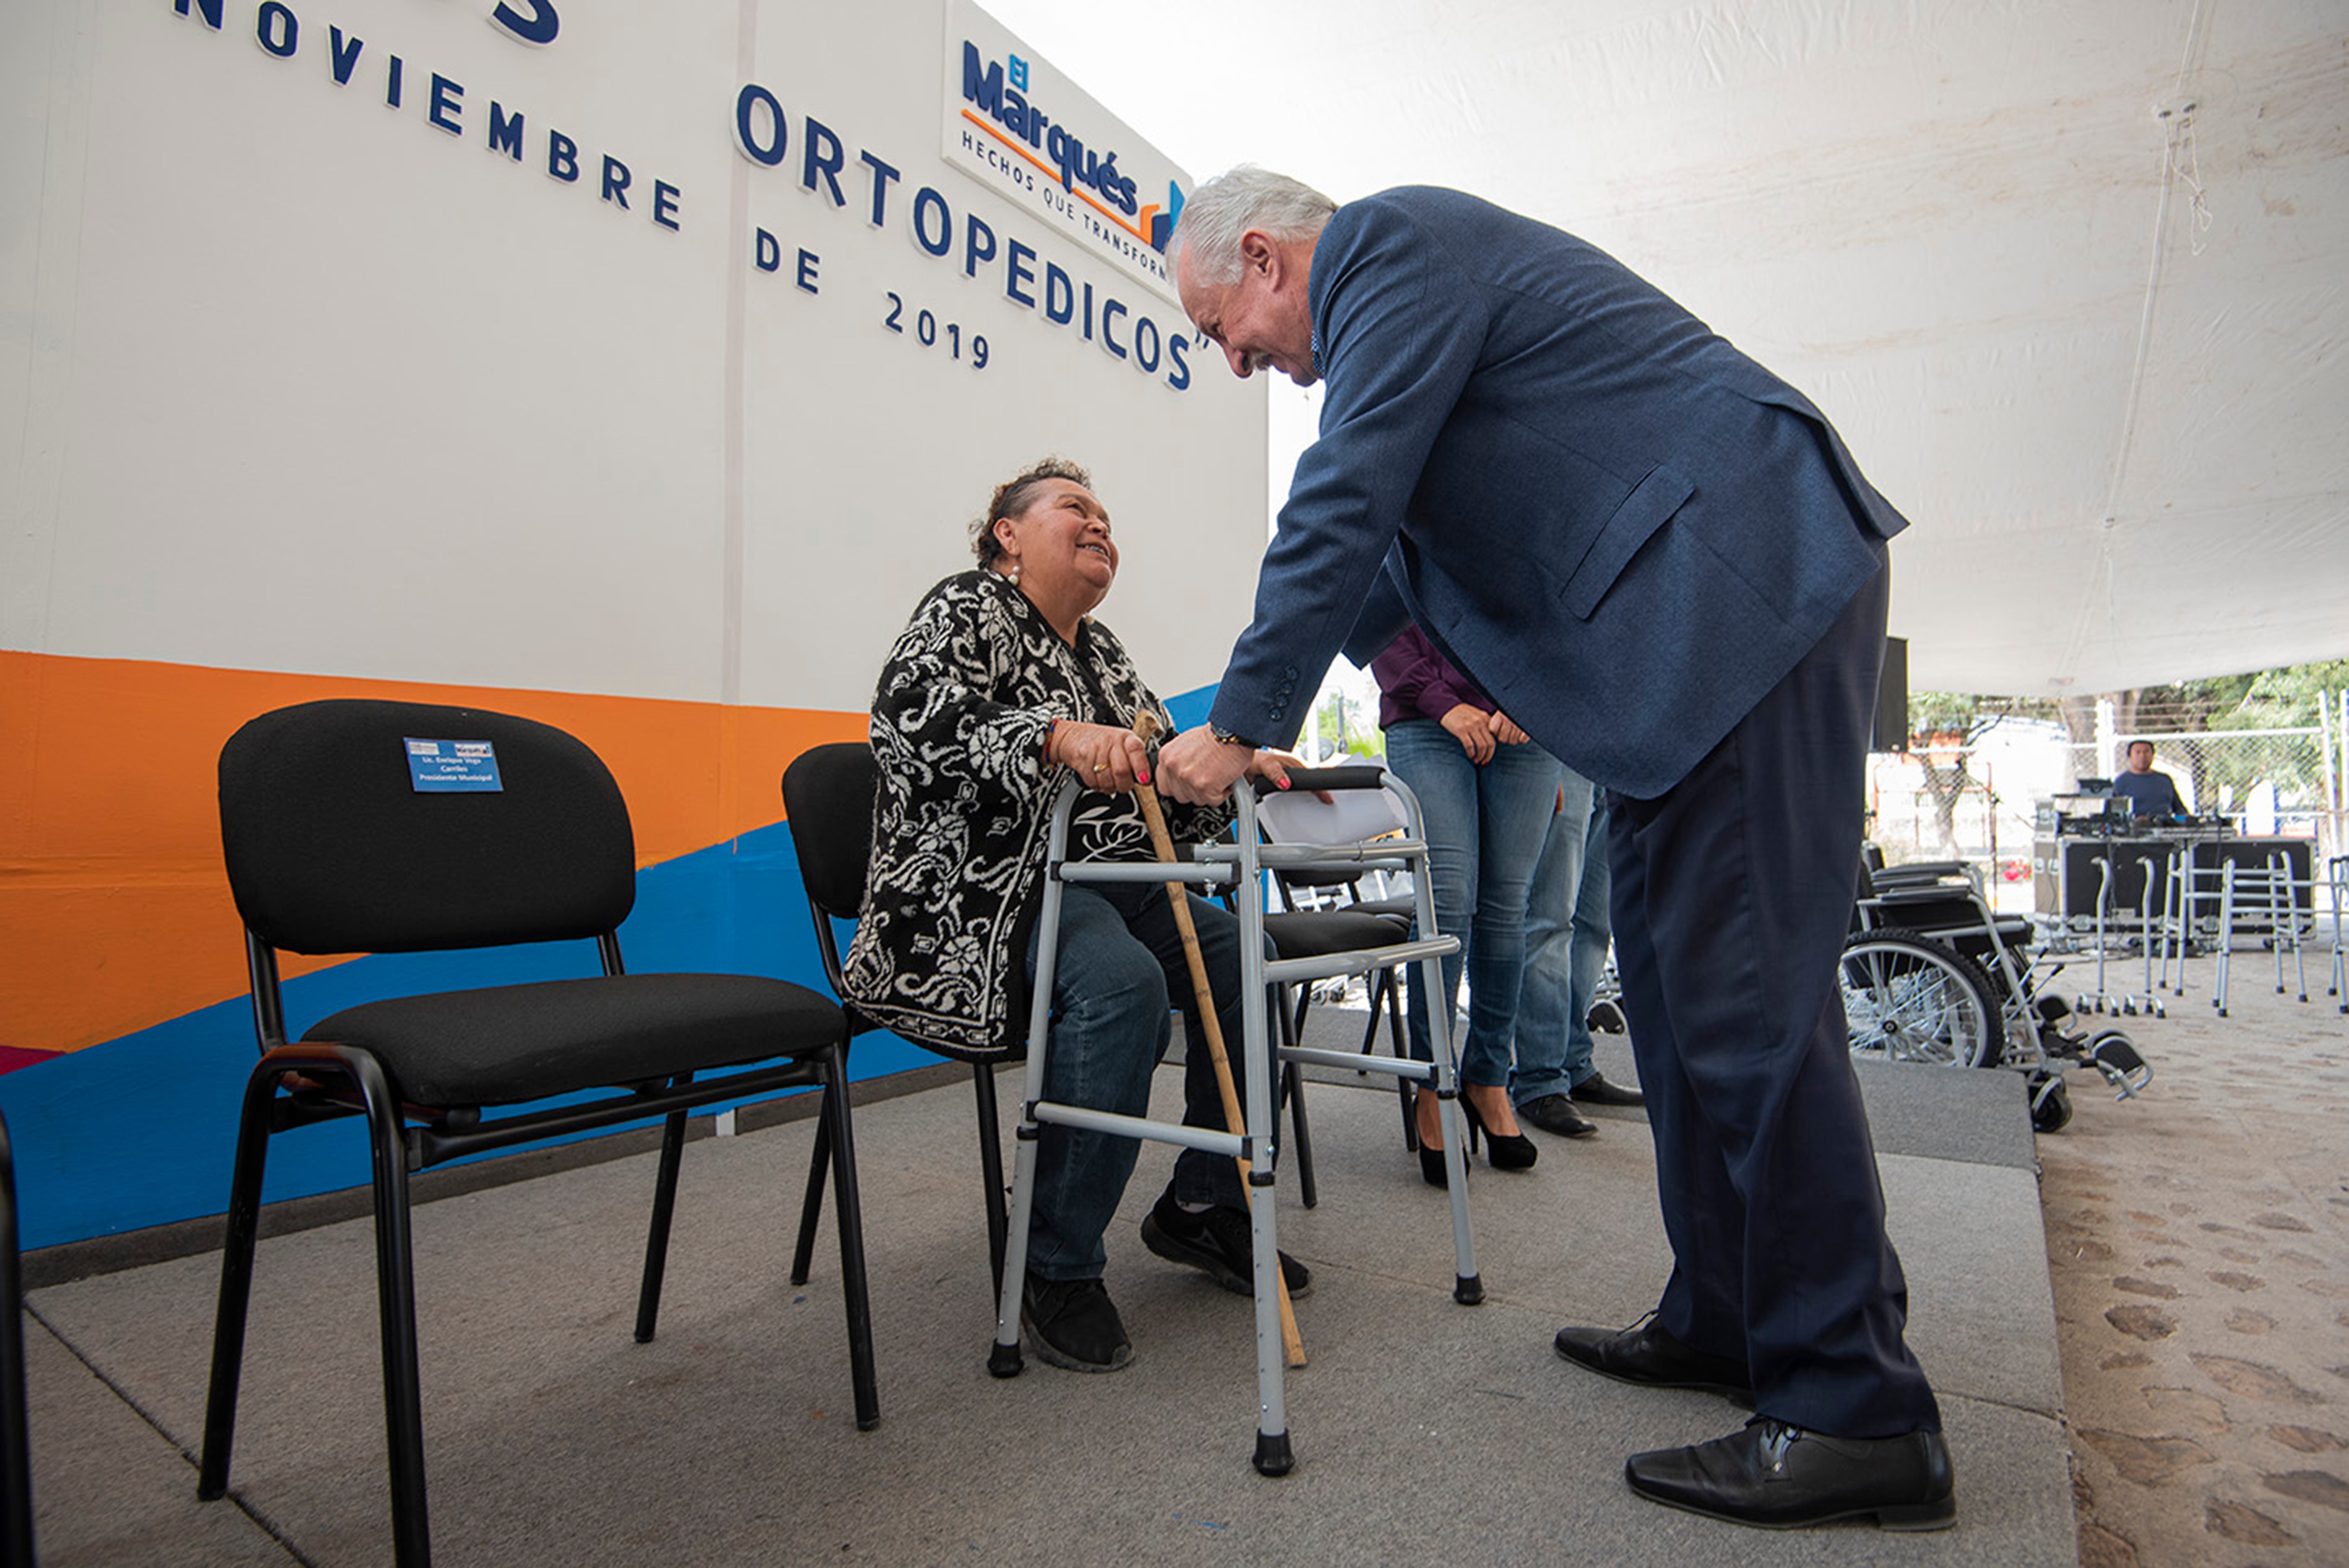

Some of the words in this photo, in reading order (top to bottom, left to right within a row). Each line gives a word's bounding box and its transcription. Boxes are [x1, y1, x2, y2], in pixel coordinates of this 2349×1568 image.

[963, 40, 1137, 216] Marqués
[1009, 54, 1028, 93] El
[962, 130, 1034, 192] HECHOS
[1043, 187, 1075, 220] QUE
[756, 228, 820, 295] DE
[885, 292, 988, 369] 2019
